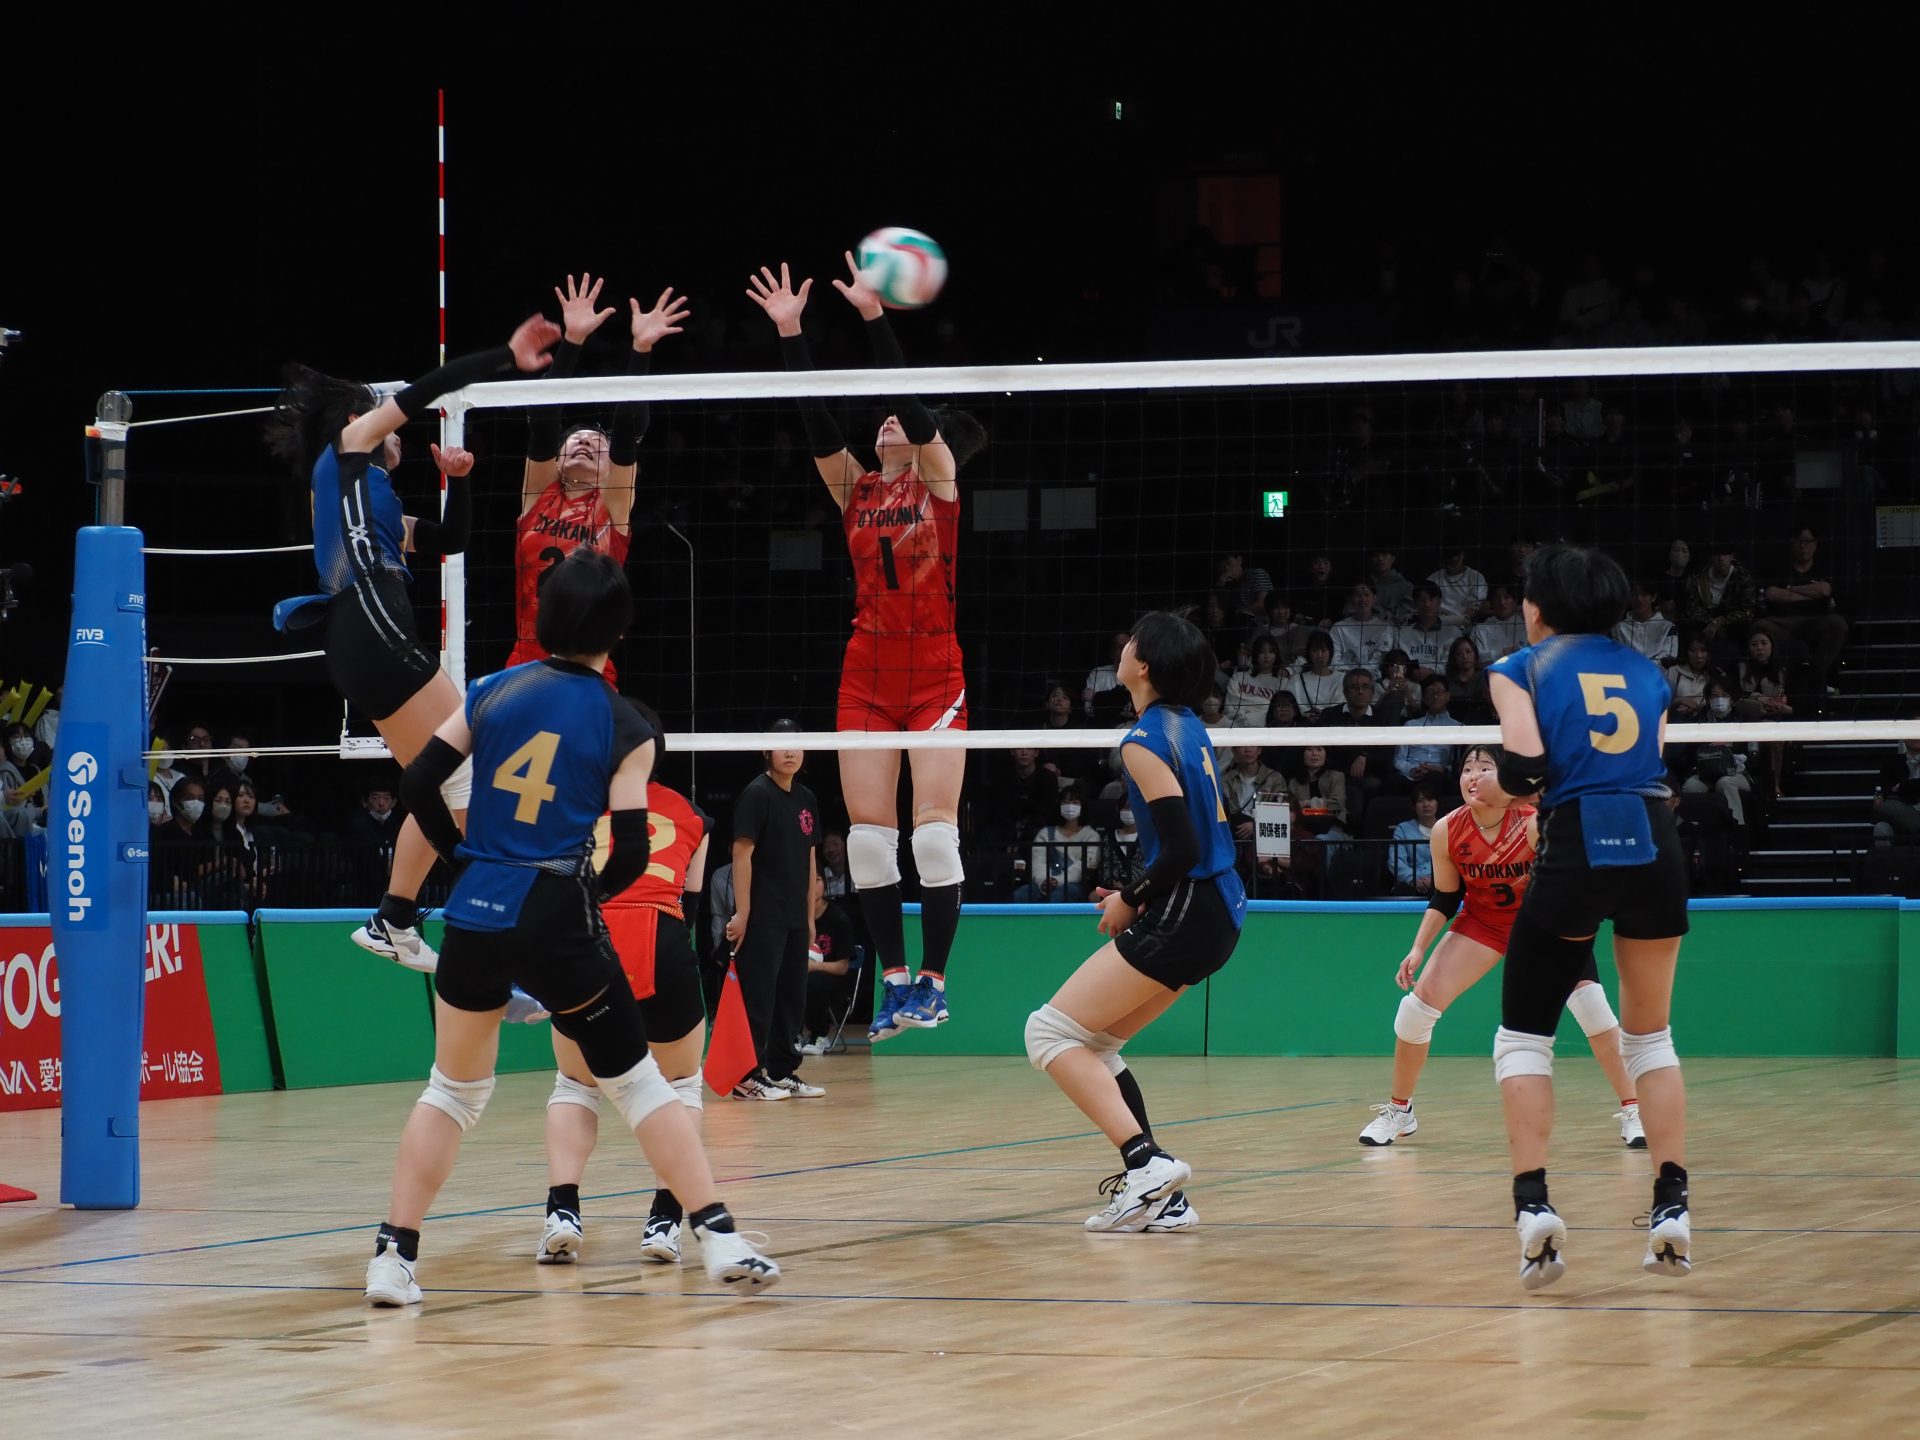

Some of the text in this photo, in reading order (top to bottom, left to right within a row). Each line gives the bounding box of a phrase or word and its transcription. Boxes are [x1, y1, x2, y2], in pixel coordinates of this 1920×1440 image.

[1248, 316, 1302, 348] JR
[879, 536, 899, 590] 1
[76, 628, 104, 641] FIVB
[1577, 672, 1640, 755] 5
[492, 730, 561, 825] 4
[1200, 746, 1228, 823] 1
[68, 789, 92, 922] Senoh
[1259, 822, 1288, 839] 関係者席
[1489, 883, 1516, 907] 3
